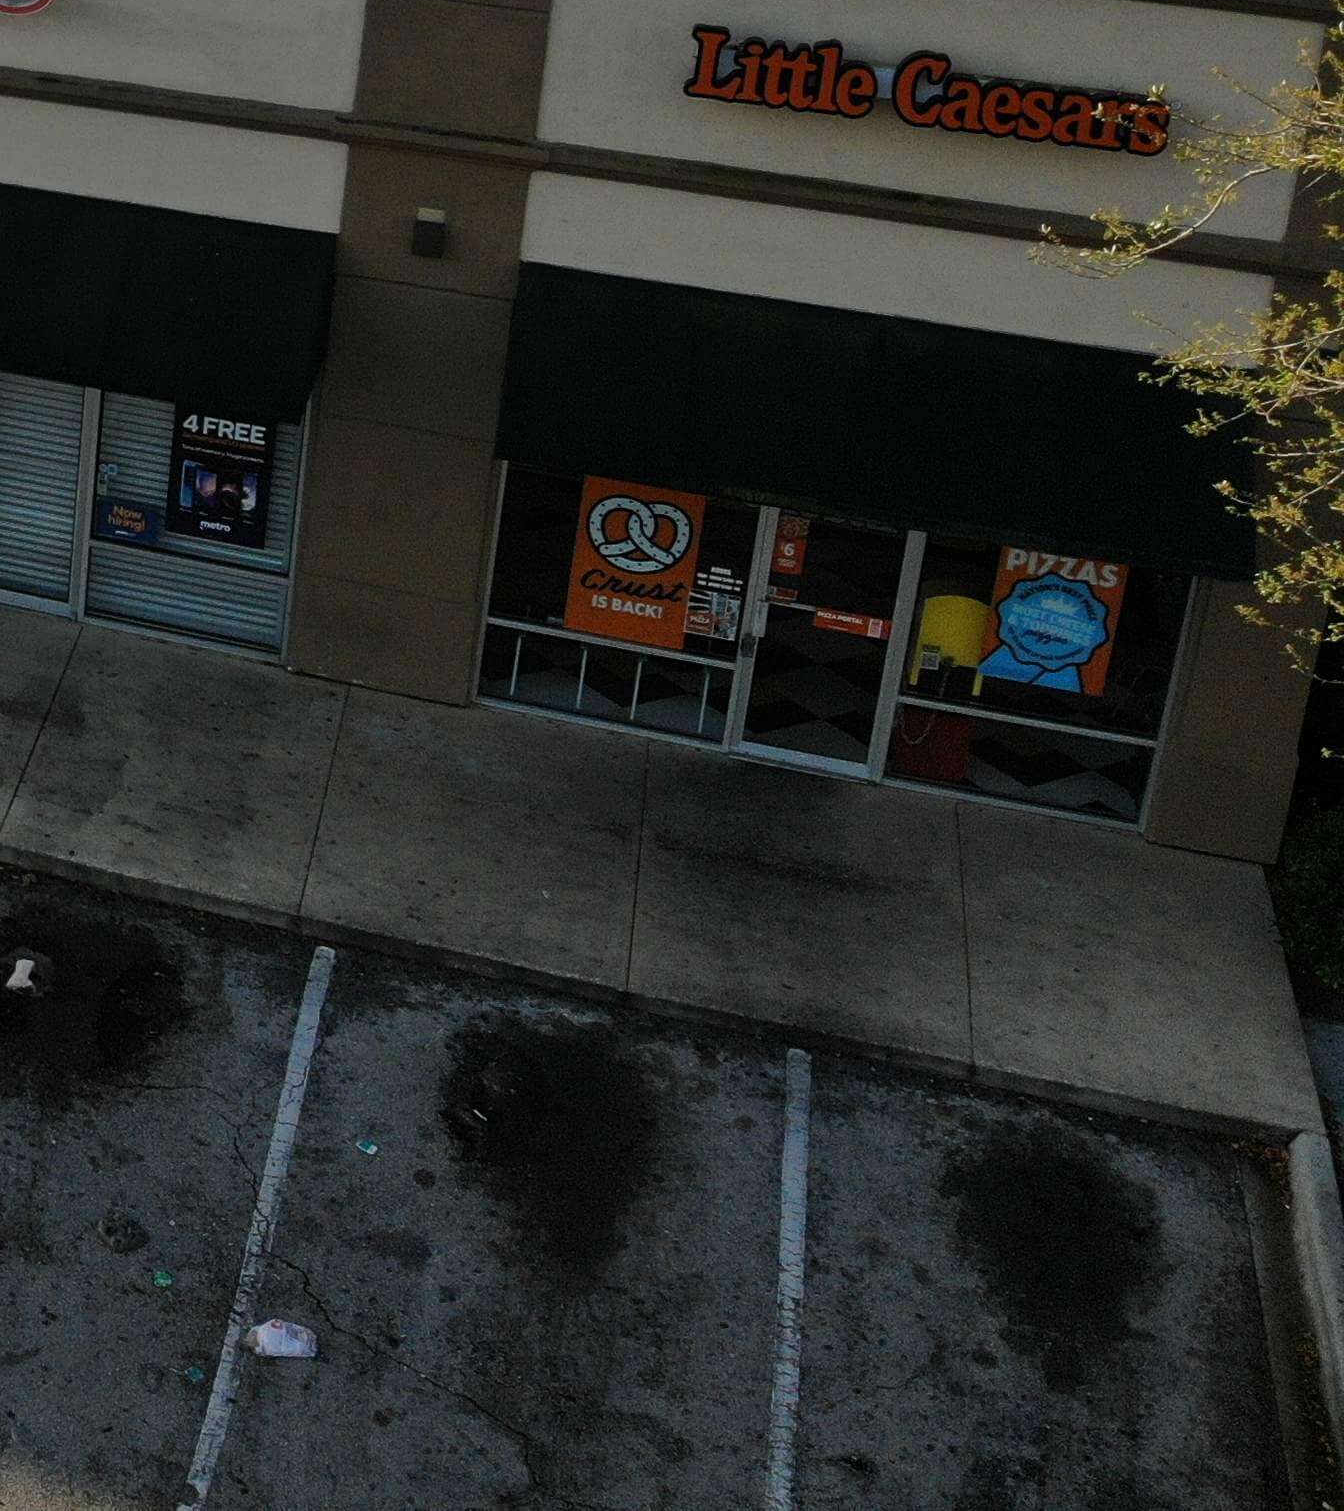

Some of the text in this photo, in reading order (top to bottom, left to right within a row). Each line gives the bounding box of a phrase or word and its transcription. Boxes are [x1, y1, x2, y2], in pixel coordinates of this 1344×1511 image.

[684, 23, 1171, 156] Little Caesars
[182, 413, 200, 434] 4
[203, 416, 267, 446] FREE
[112, 504, 144, 521] Now
[200, 520, 232, 533] metro
[1006, 547, 1119, 588] PIZZAS
[580, 568, 688, 603] Crust
[591, 593, 664, 620] IS BACK!
